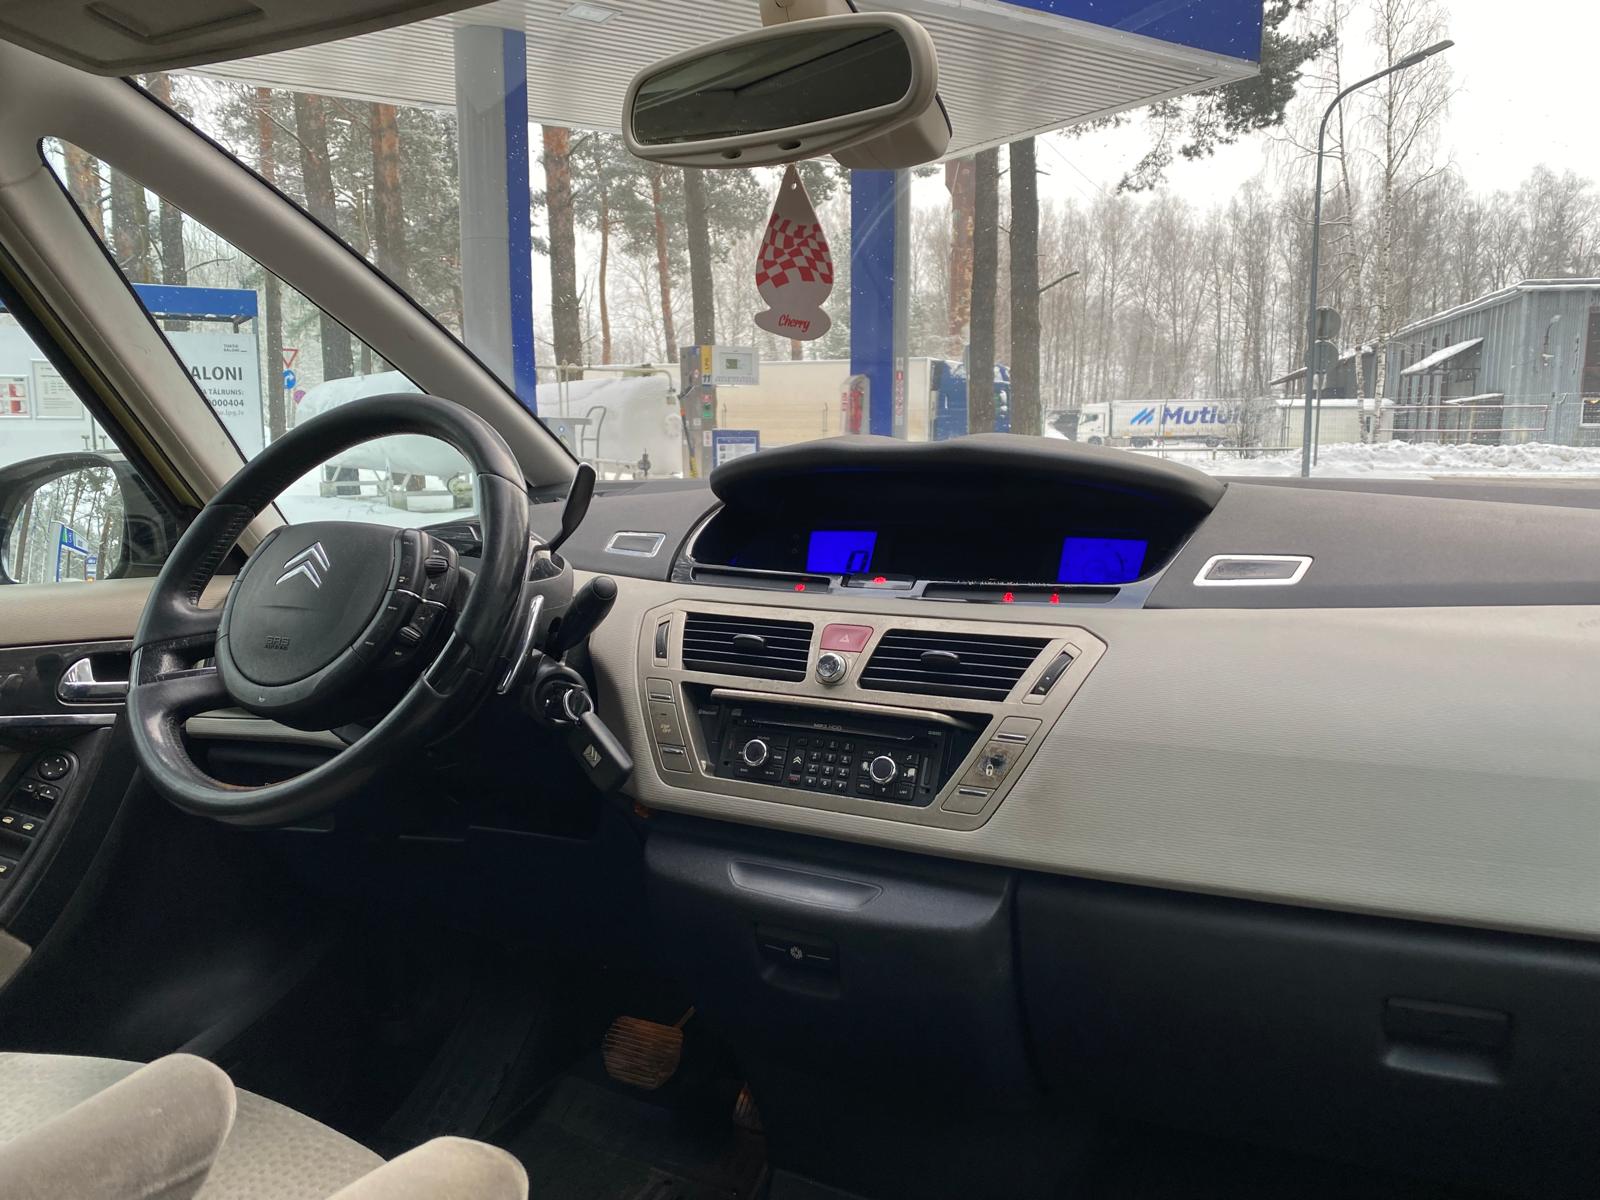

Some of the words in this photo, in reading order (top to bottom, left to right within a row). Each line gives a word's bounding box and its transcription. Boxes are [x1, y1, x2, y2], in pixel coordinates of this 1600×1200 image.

[778, 313, 810, 333] Cherry
[191, 366, 243, 381] ALONI
[209, 399, 245, 407] 000404
[846, 550, 869, 574] 0
